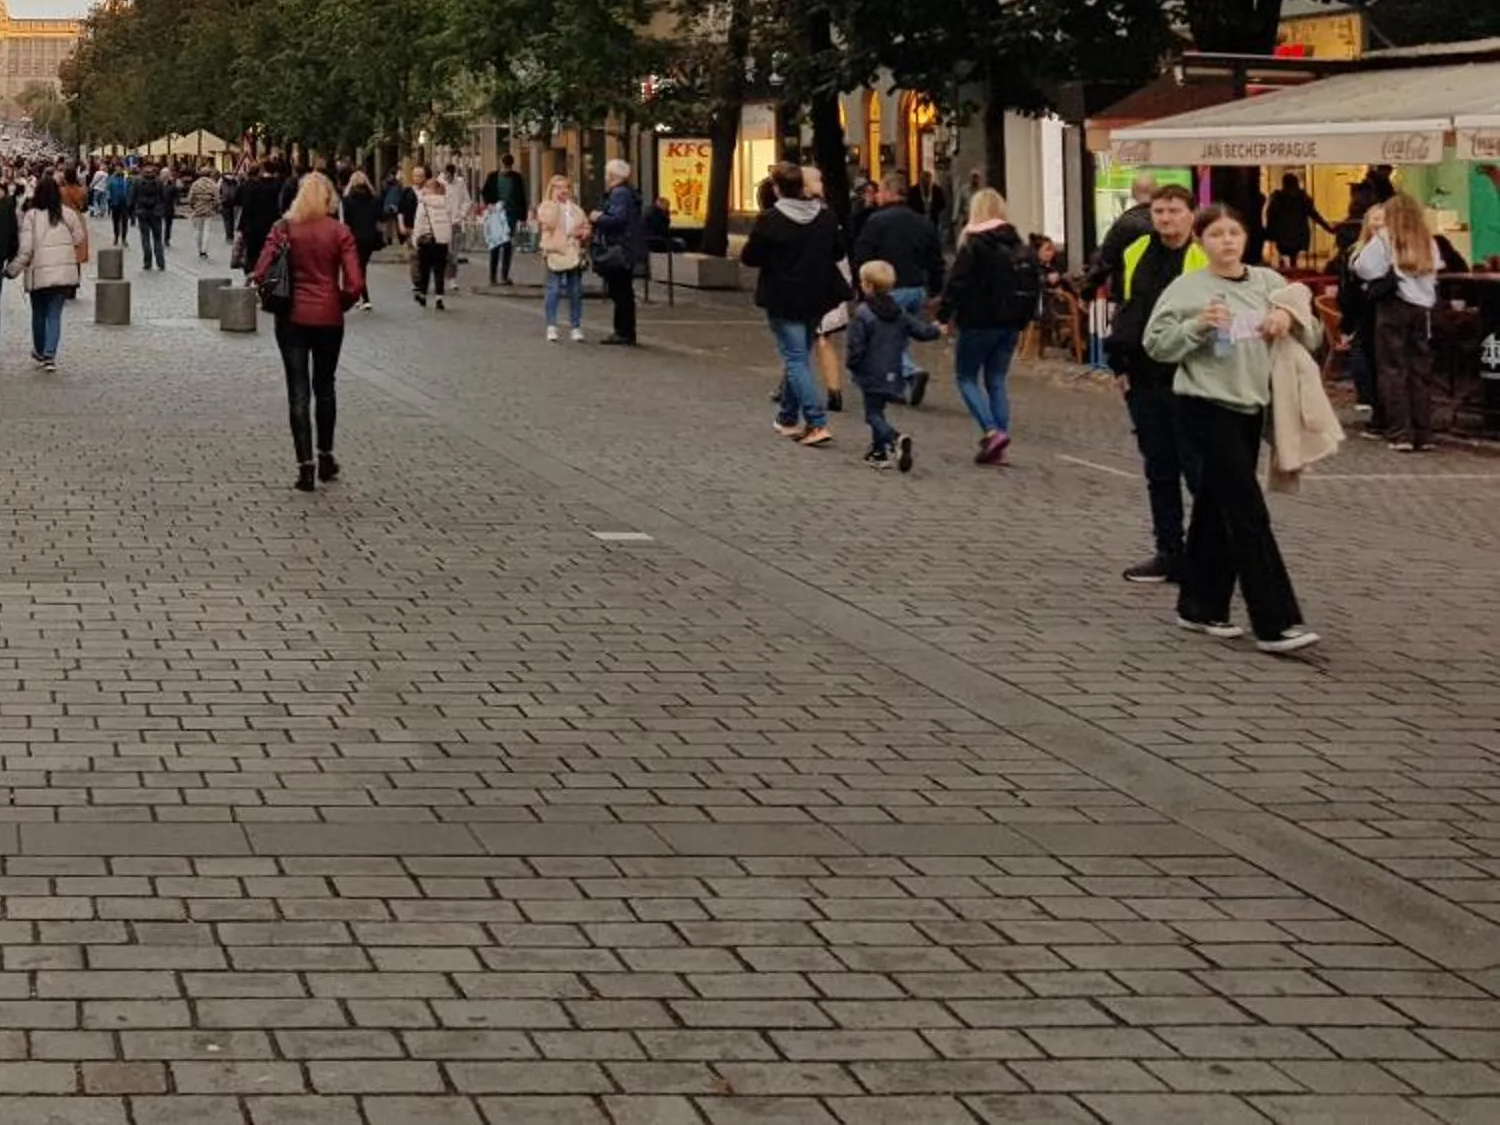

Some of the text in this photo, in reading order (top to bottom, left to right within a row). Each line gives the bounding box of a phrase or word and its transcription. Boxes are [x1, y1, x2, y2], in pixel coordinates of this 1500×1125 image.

[667, 142, 709, 158] KFC
[1201, 141, 1318, 159] JAN BECHER PRAGUE
